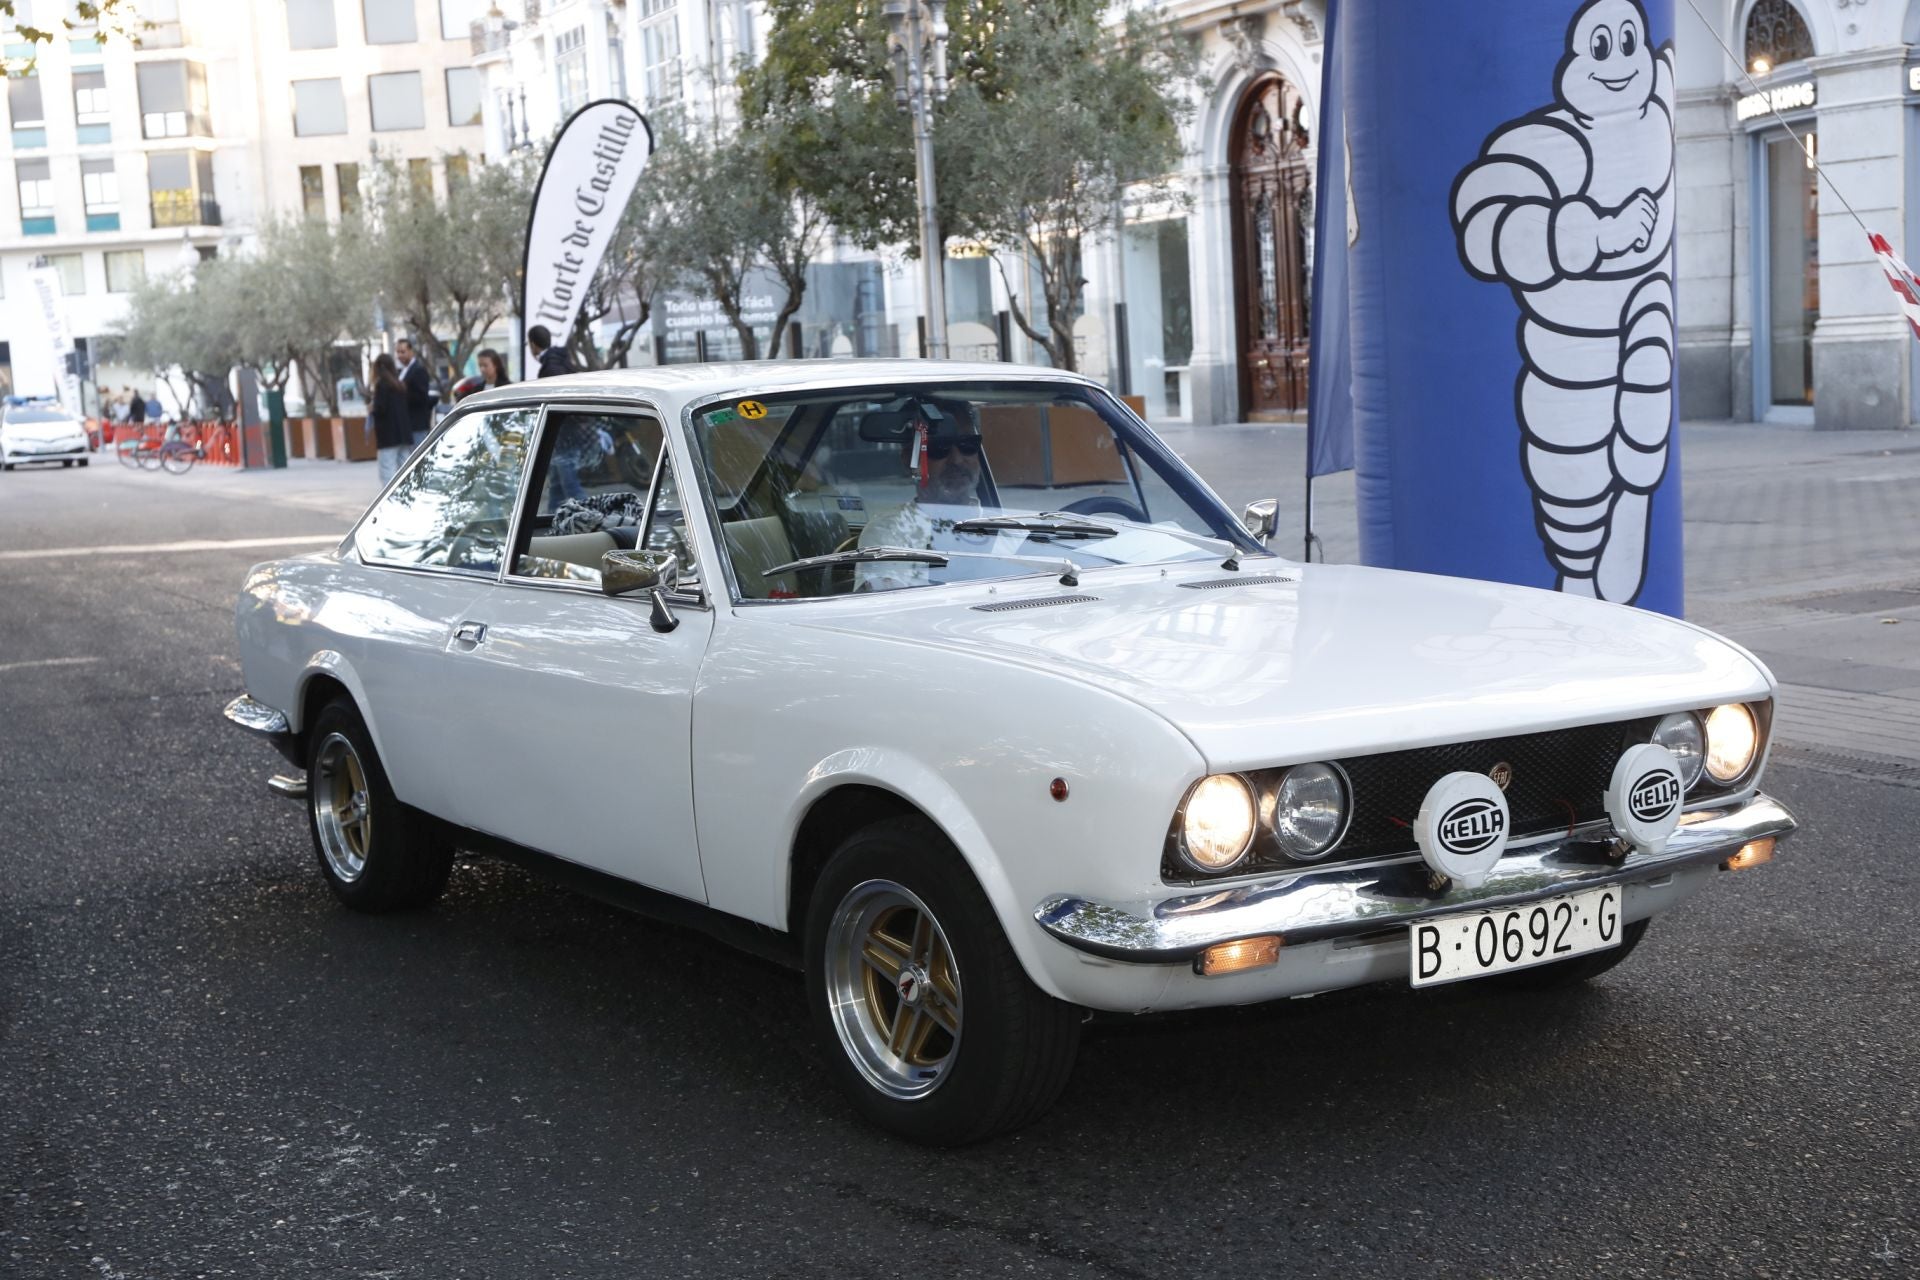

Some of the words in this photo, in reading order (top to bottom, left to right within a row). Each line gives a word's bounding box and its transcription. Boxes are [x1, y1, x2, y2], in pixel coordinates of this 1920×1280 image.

[575, 113, 637, 217] Castilla
[561, 219, 595, 249] de
[664, 301, 697, 315] Todo
[665, 312, 713, 328] cuando
[741, 402, 762, 417] H
[1632, 778, 1680, 810] HELLA
[1442, 808, 1504, 840] HELLA
